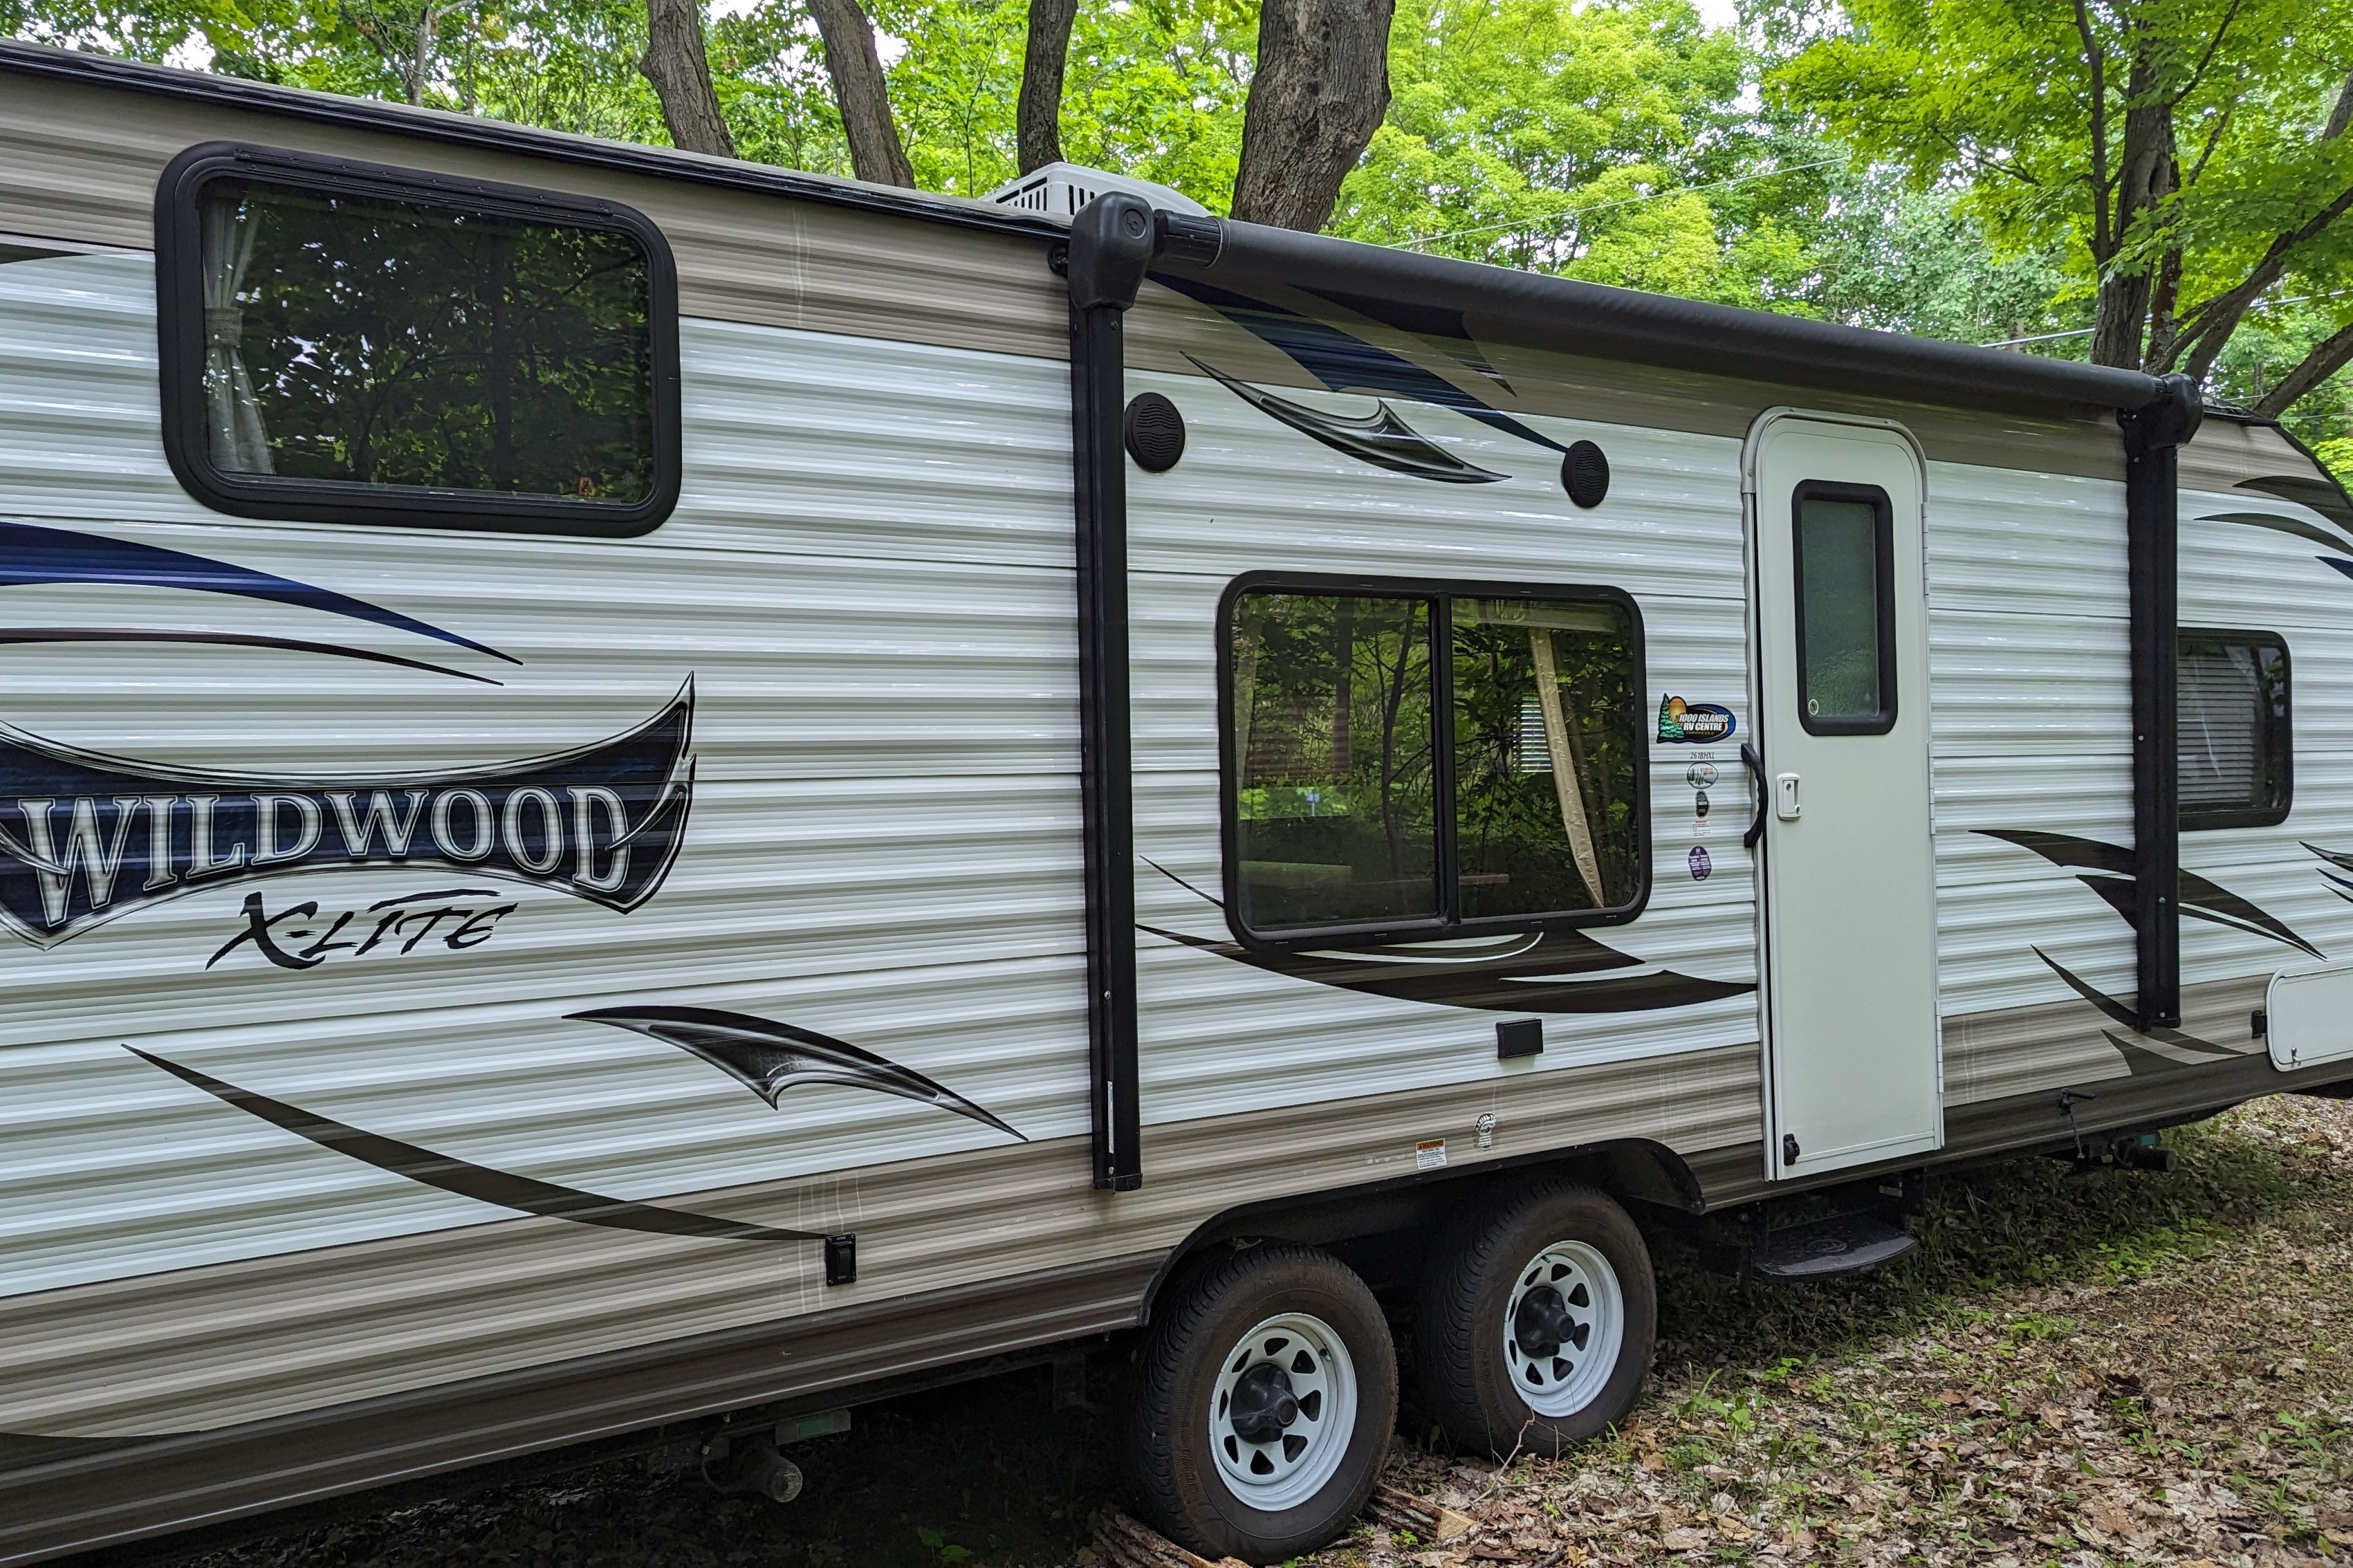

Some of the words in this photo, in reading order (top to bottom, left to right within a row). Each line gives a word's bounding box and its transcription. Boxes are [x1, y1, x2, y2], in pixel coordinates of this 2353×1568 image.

[1679, 714, 1698, 722] 1000
[1698, 714, 1729, 723] ISLANDS
[1695, 723, 1723, 731] CENTRE
[17, 786, 631, 928] WILDWOOD
[205, 888, 519, 971] X-LITE
[1475, 1114, 1491, 1132] RADIAL
